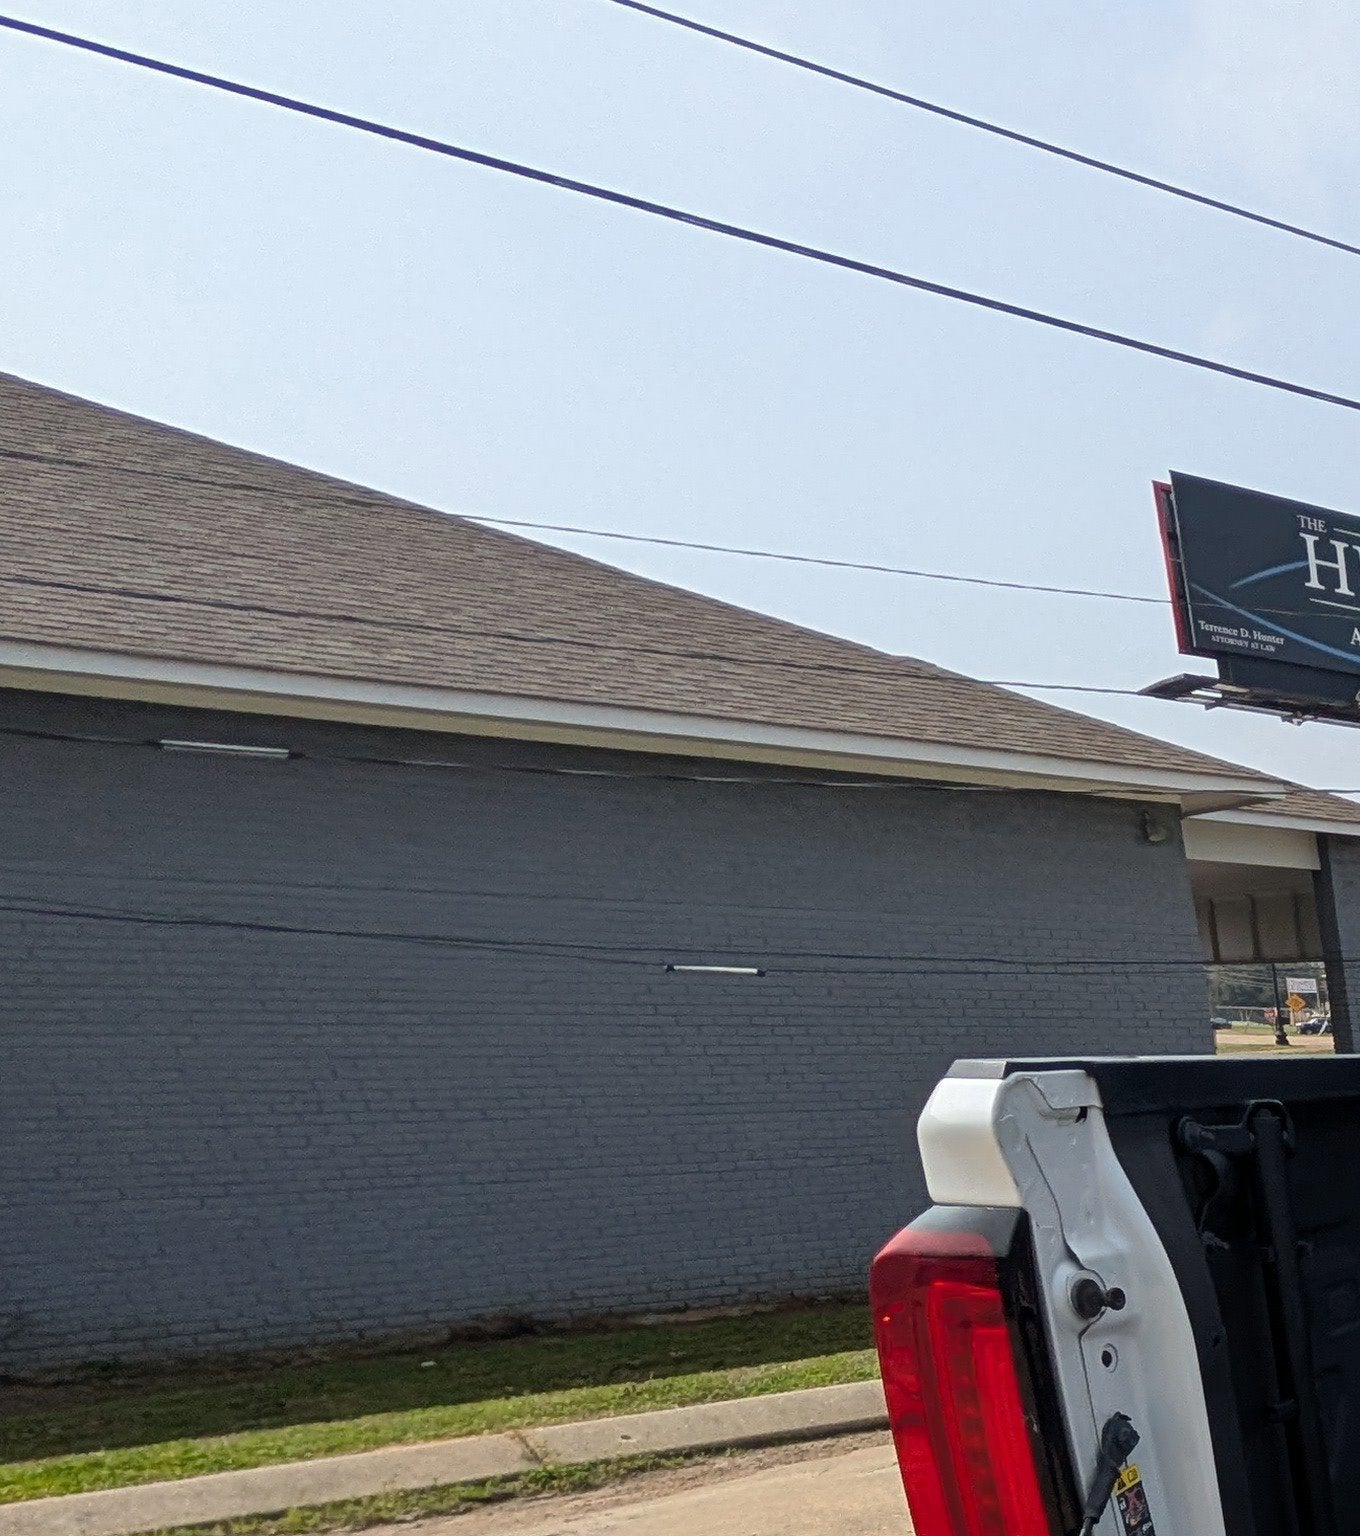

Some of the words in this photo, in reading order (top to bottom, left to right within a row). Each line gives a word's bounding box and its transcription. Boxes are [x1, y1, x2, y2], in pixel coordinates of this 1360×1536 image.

[1297, 515, 1327, 533] THE
[1198, 620, 1238, 636] Terrence
[1253, 631, 1285, 645] Hunter
